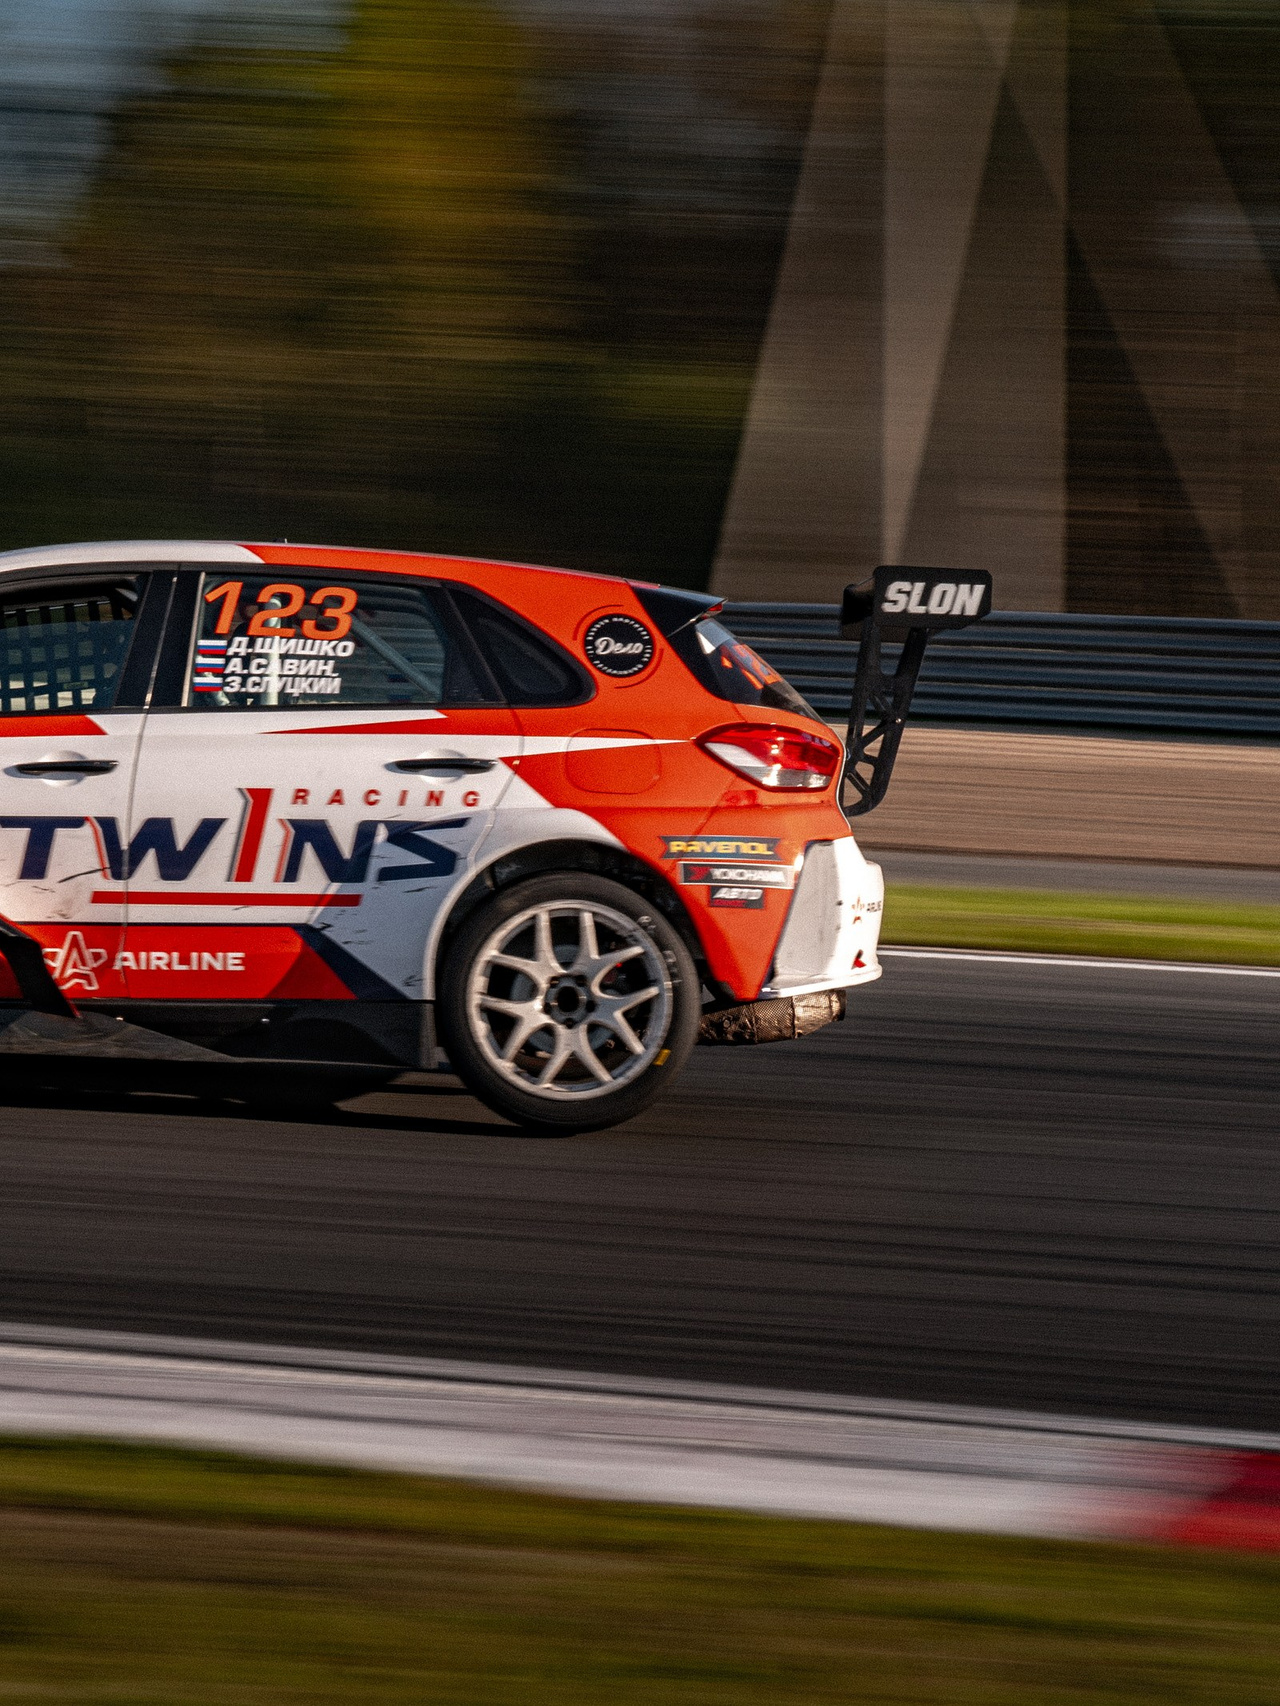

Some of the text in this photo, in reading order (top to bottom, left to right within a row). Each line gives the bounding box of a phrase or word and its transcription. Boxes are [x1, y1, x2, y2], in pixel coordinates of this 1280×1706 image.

[881, 580, 986, 616] SLON
[204, 581, 358, 641] 123
[226, 636, 355, 657] Д.ШИШКО
[291, 787, 482, 808] RACING
[669, 841, 775, 856] RAVENOL
[113, 951, 246, 972] AIRLINE
